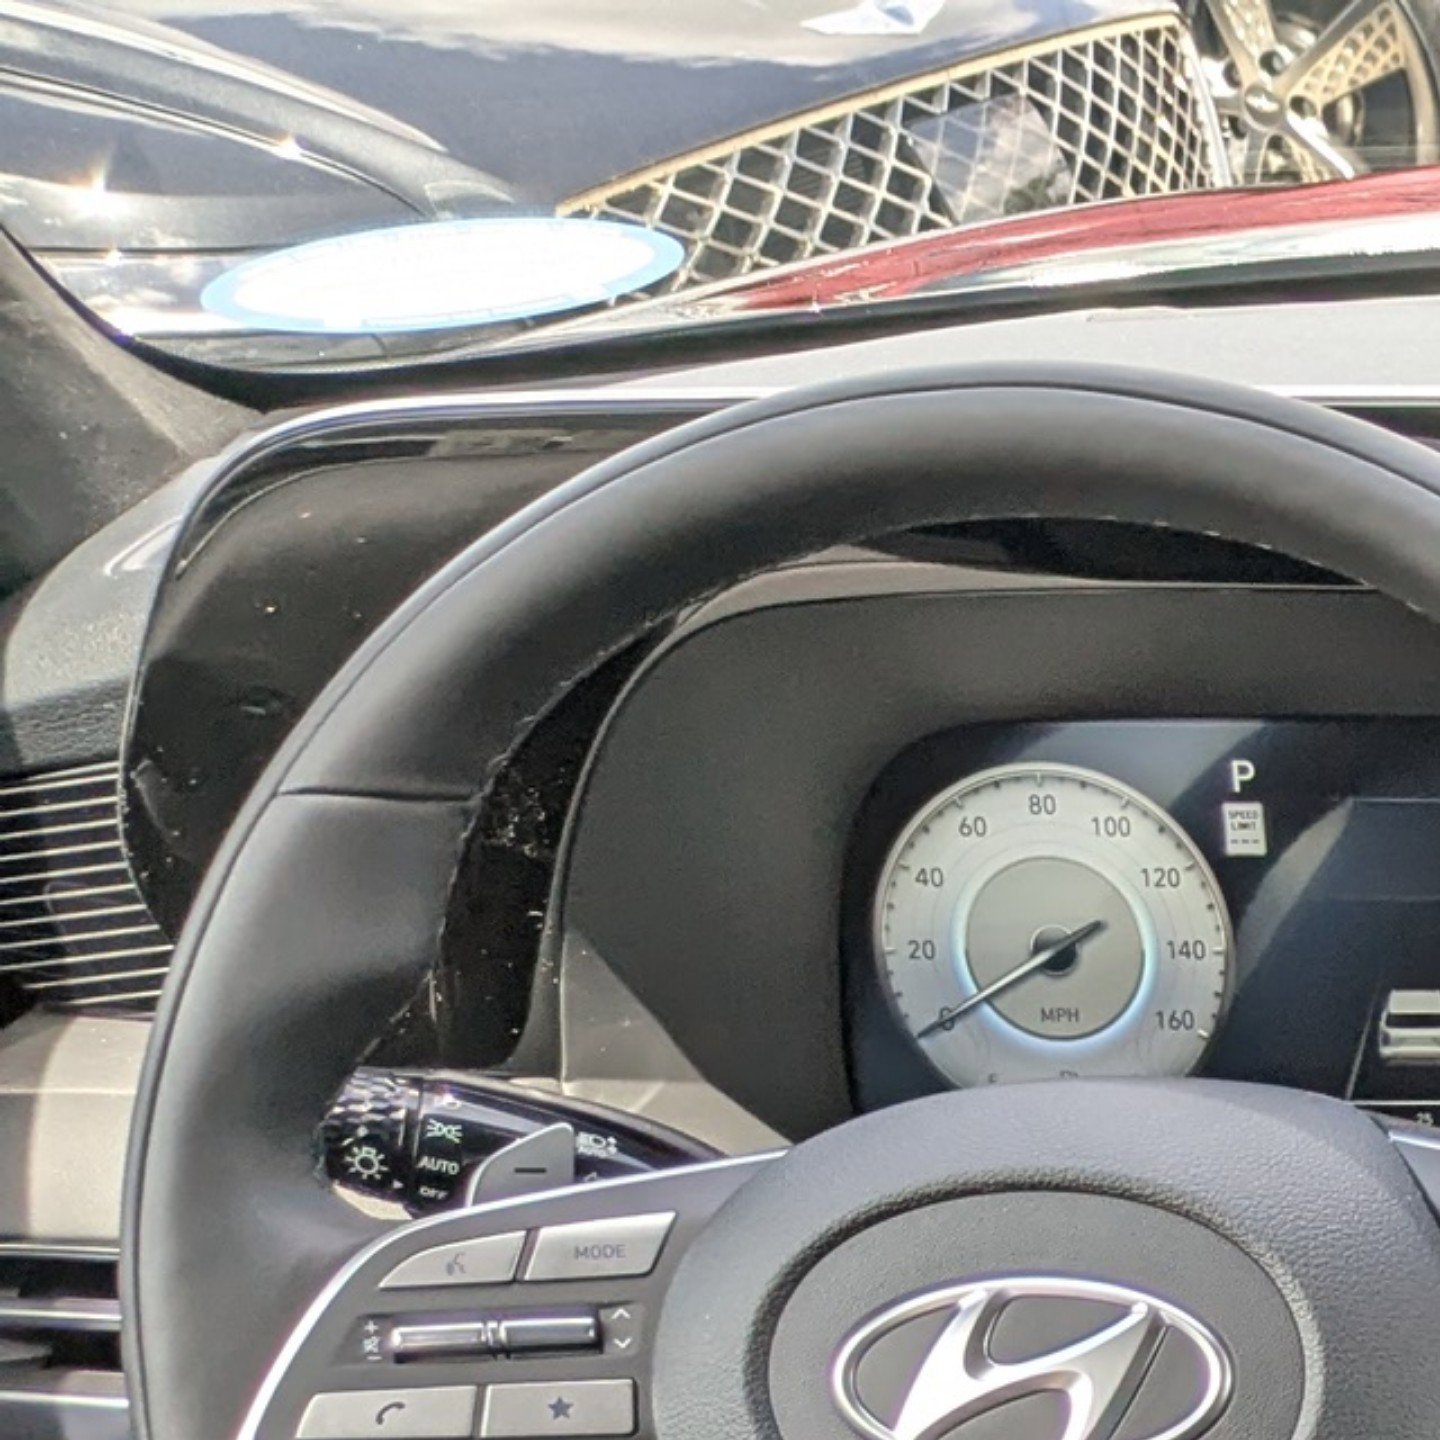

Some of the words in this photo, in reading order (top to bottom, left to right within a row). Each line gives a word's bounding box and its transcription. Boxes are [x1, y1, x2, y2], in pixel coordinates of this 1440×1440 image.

[1231, 759, 1256, 794] P
[1028, 794, 1057, 816] 80
[958, 817, 988, 838] 60
[1091, 816, 1131, 838] 100
[914, 868, 944, 888] 40
[1141, 868, 1181, 888] 120
[908, 940, 936, 960] 20
[1166, 940, 1206, 960] 140
[1040, 1008, 1080, 1023] MPH
[1155, 1010, 1195, 1031] 160
[416, 1155, 460, 1176] AUTO
[420, 1186, 449, 1200] OFF
[574, 1244, 627, 1260] MODE
